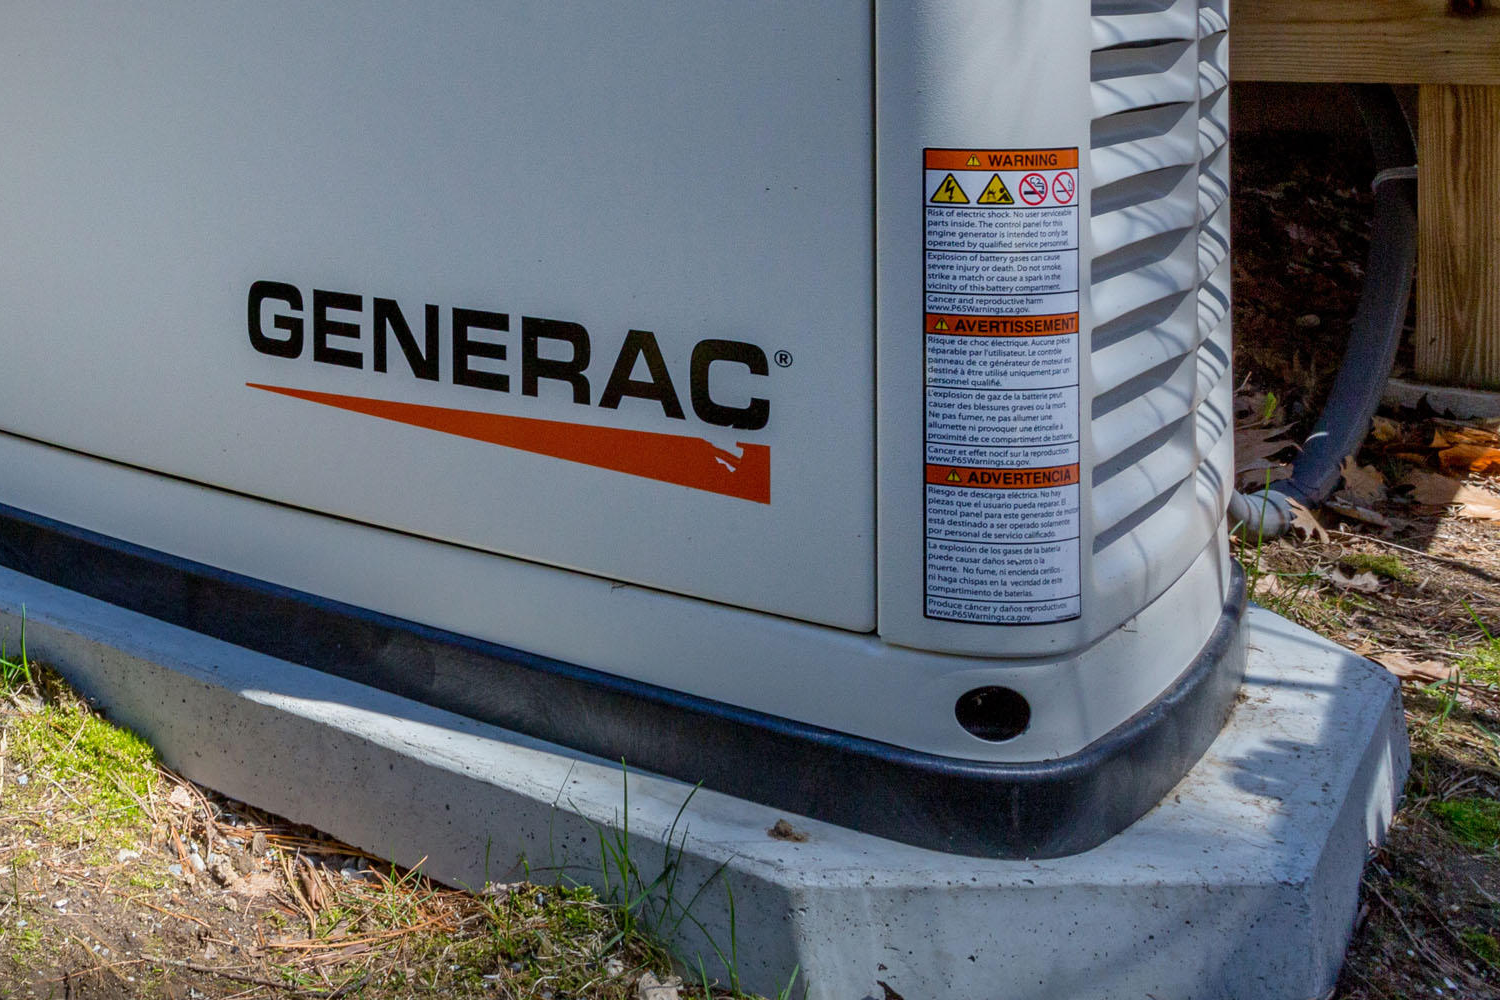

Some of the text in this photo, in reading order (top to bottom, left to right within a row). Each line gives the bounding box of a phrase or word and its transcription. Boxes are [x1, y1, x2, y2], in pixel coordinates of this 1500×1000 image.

[988, 154, 1058, 167] WARNING
[927, 209, 943, 217] Risk
[956, 210, 985, 218] electric
[927, 219, 948, 229] parts
[1022, 220, 1041, 230] panel
[927, 229, 1038, 240] engine generator intended
[927, 239, 1038, 250] operated by qualified service
[927, 252, 967, 263] Explosion
[969, 254, 978, 262] of
[979, 254, 1007, 264] battery
[1009, 256, 1029, 264] gases
[956, 263, 979, 273] injury
[1017, 264, 1027, 272] Do
[1029, 264, 1040, 272] not
[927, 272, 949, 280] strike
[959, 273, 985, 282] match
[1024, 274, 1042, 283] spark
[927, 282, 956, 292] vicinity
[959, 283, 967, 291] of
[969, 284, 984, 292] this
[986, 284, 1013, 294] battery
[927, 294, 1043, 307] Cancer and reproductive harm
[955, 317, 1075, 333] AVERTISSEMENT
[927, 336, 956, 347] Risque
[957, 338, 967, 346] de
[969, 339, 989, 347] choc
[927, 346, 966, 358] réparable
[969, 350, 982, 358] par
[927, 357, 964, 367] panneau
[966, 358, 977, 366] de
[989, 359, 1030, 368] générateur
[927, 365, 1051, 378] destiné être utilisé uniquement
[927, 375, 969, 387] personnel
[927, 389, 1048, 402] L'explosion de gaz de la batterie
[928, 401, 955, 409] causer
[957, 402, 971, 410] des
[973, 403, 1010, 411] blessures
[1011, 405, 1034, 413] graves
[928, 410, 940, 418] Ne
[942, 413, 956, 422] pas
[998, 416, 1011, 424] pas
[1012, 414, 1039, 422] allumer
[928, 421, 966, 431] allumette
[968, 424, 976, 432] ni
[977, 426, 1017, 434] provoquer
[928, 431, 966, 443] proximité
[968, 434, 978, 442] de
[991, 435, 1042, 445] compartiment
[927, 445, 956, 455] Cancer
[958, 448, 966, 456] et
[968, 448, 987, 457] effet
[967, 469, 1071, 485] ADVERTENCIA
[928, 486, 956, 498] Riesgo
[957, 489, 967, 497] de
[970, 490, 1005, 501] descarga
[928, 496, 1035, 511] piezas que usuario pueda
[928, 506, 957, 516] control
[959, 509, 982, 520] panel
[984, 512, 1002, 521] para
[1003, 511, 1019, 519] este
[947, 518, 987, 528] destinado
[1009, 521, 1039, 531] operado
[928, 527, 942, 536] por
[944, 528, 980, 540] personal
[994, 531, 1023, 539] servicio
[928, 541, 937, 549] La
[978, 546, 989, 554] de
[990, 546, 1001, 554] los
[1003, 548, 1022, 556] gases
[1024, 546, 1032, 554] de
[928, 552, 953, 564] puede
[955, 556, 980, 564] causar
[962, 566, 973, 574] No
[1008, 567, 1039, 575] encienda
[938, 574, 957, 585] haga
[959, 576, 988, 587] chispas
[1010, 578, 1040, 586] vecindad
[928, 583, 1002, 598] compartimiento de
[928, 598, 962, 610] Produce
